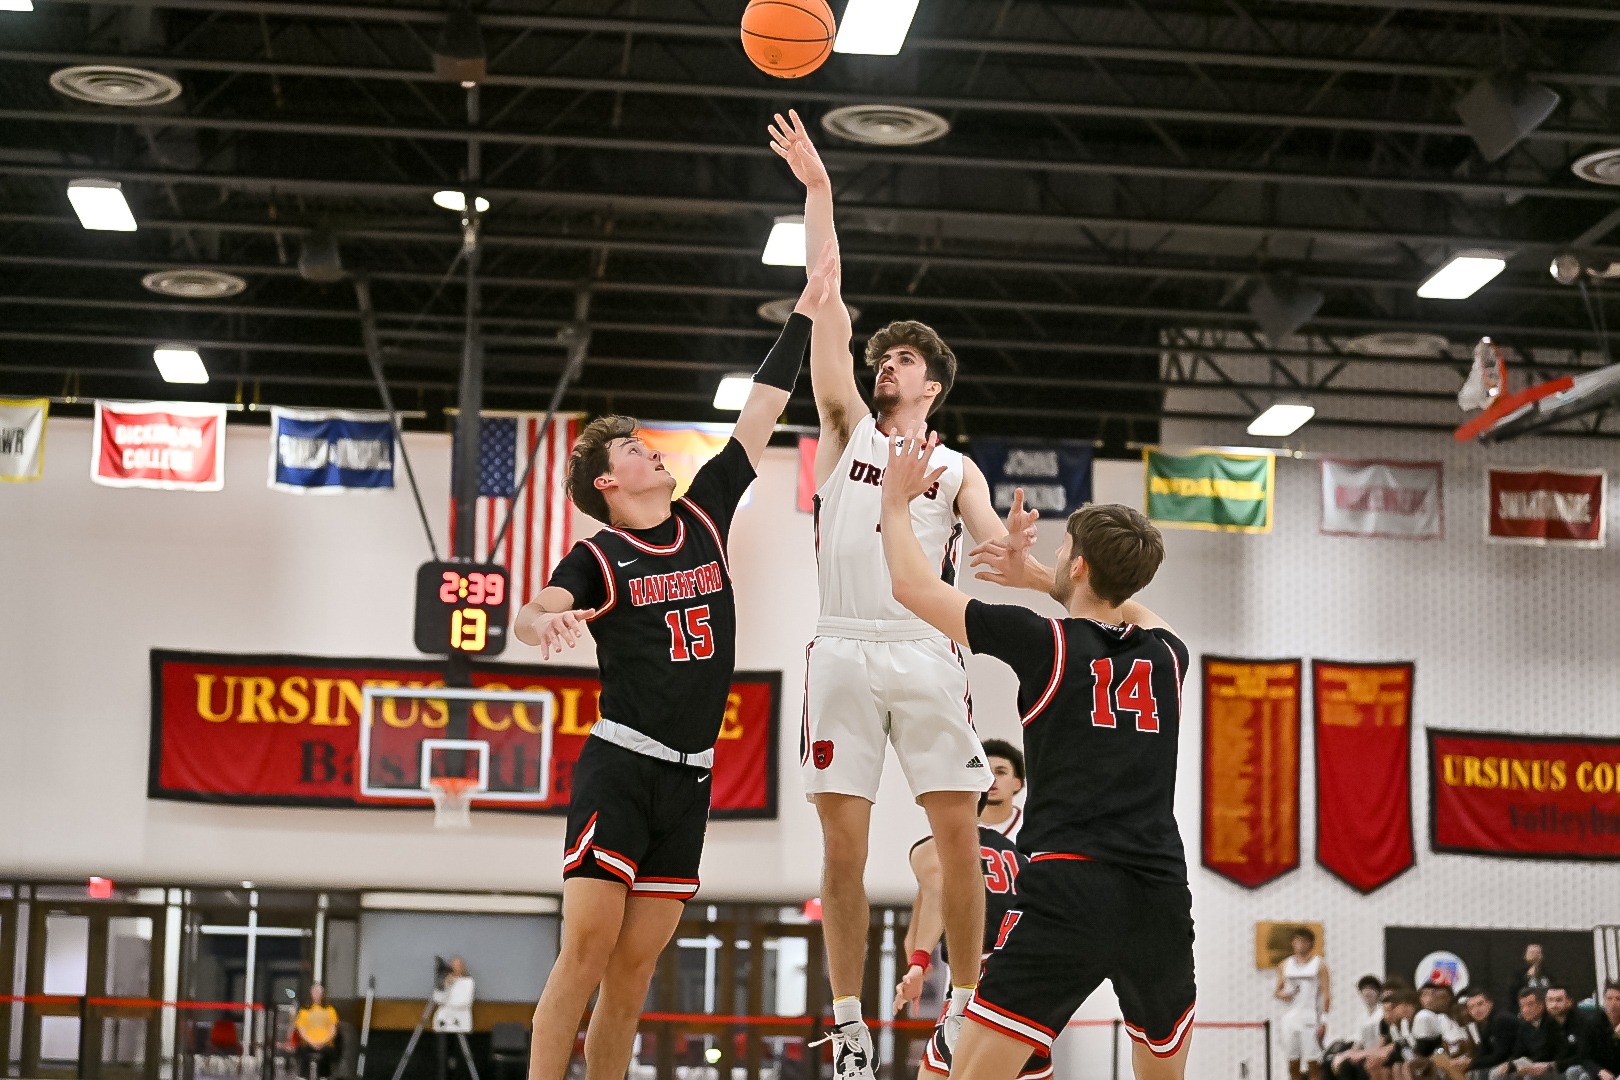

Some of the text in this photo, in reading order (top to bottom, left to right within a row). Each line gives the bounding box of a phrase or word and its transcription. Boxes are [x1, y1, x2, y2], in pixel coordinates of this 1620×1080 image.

[439, 571, 504, 605] 2:39
[629, 561, 722, 606] HAVERFORD
[450, 608, 486, 651] 13
[665, 605, 715, 662] 15
[194, 673, 450, 729] URSINUS
[1090, 657, 1160, 733] 14
[1443, 754, 1568, 792] URSINUS
